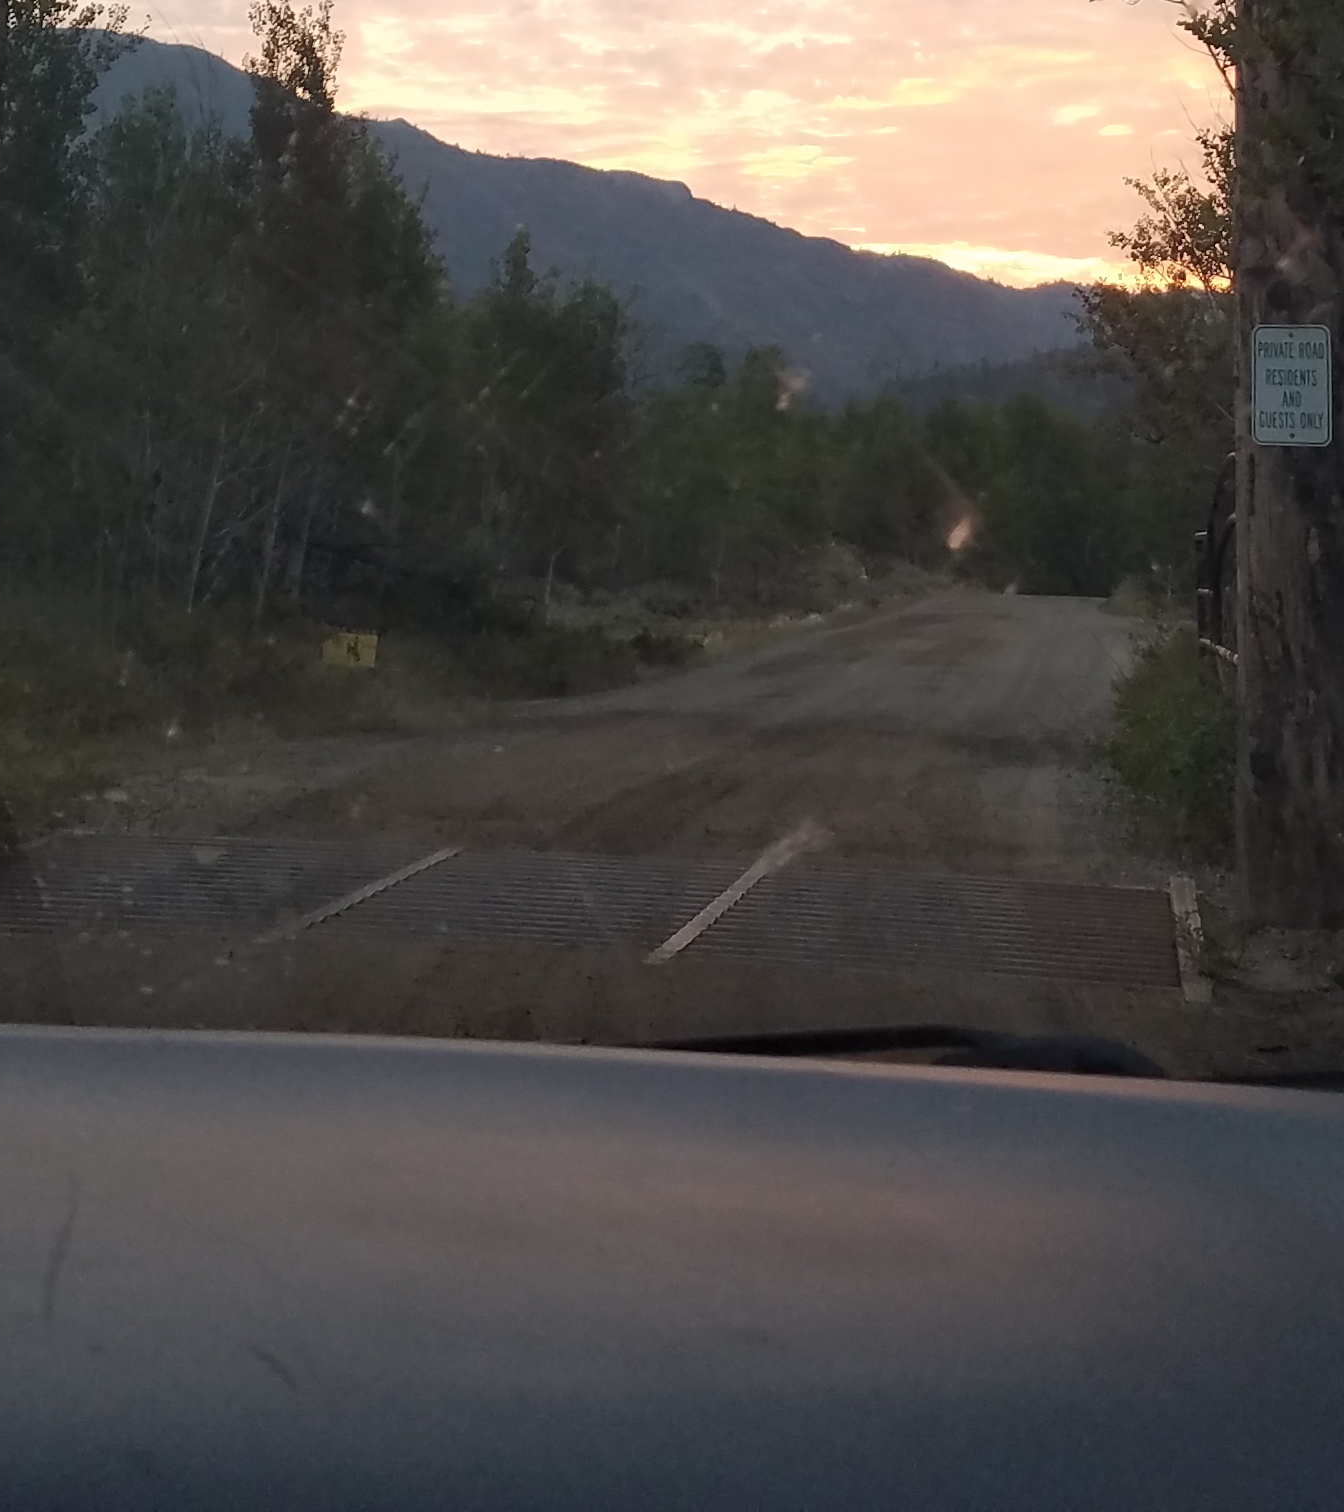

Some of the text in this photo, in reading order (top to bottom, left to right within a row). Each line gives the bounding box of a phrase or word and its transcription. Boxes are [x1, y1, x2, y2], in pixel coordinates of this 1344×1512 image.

[1258, 341, 1325, 359] PRIVATE ROAD
[1265, 368, 1318, 387] RESIDENTS
[1281, 390, 1302, 408] AND
[1259, 411, 1324, 430] GUESTS ONLY
